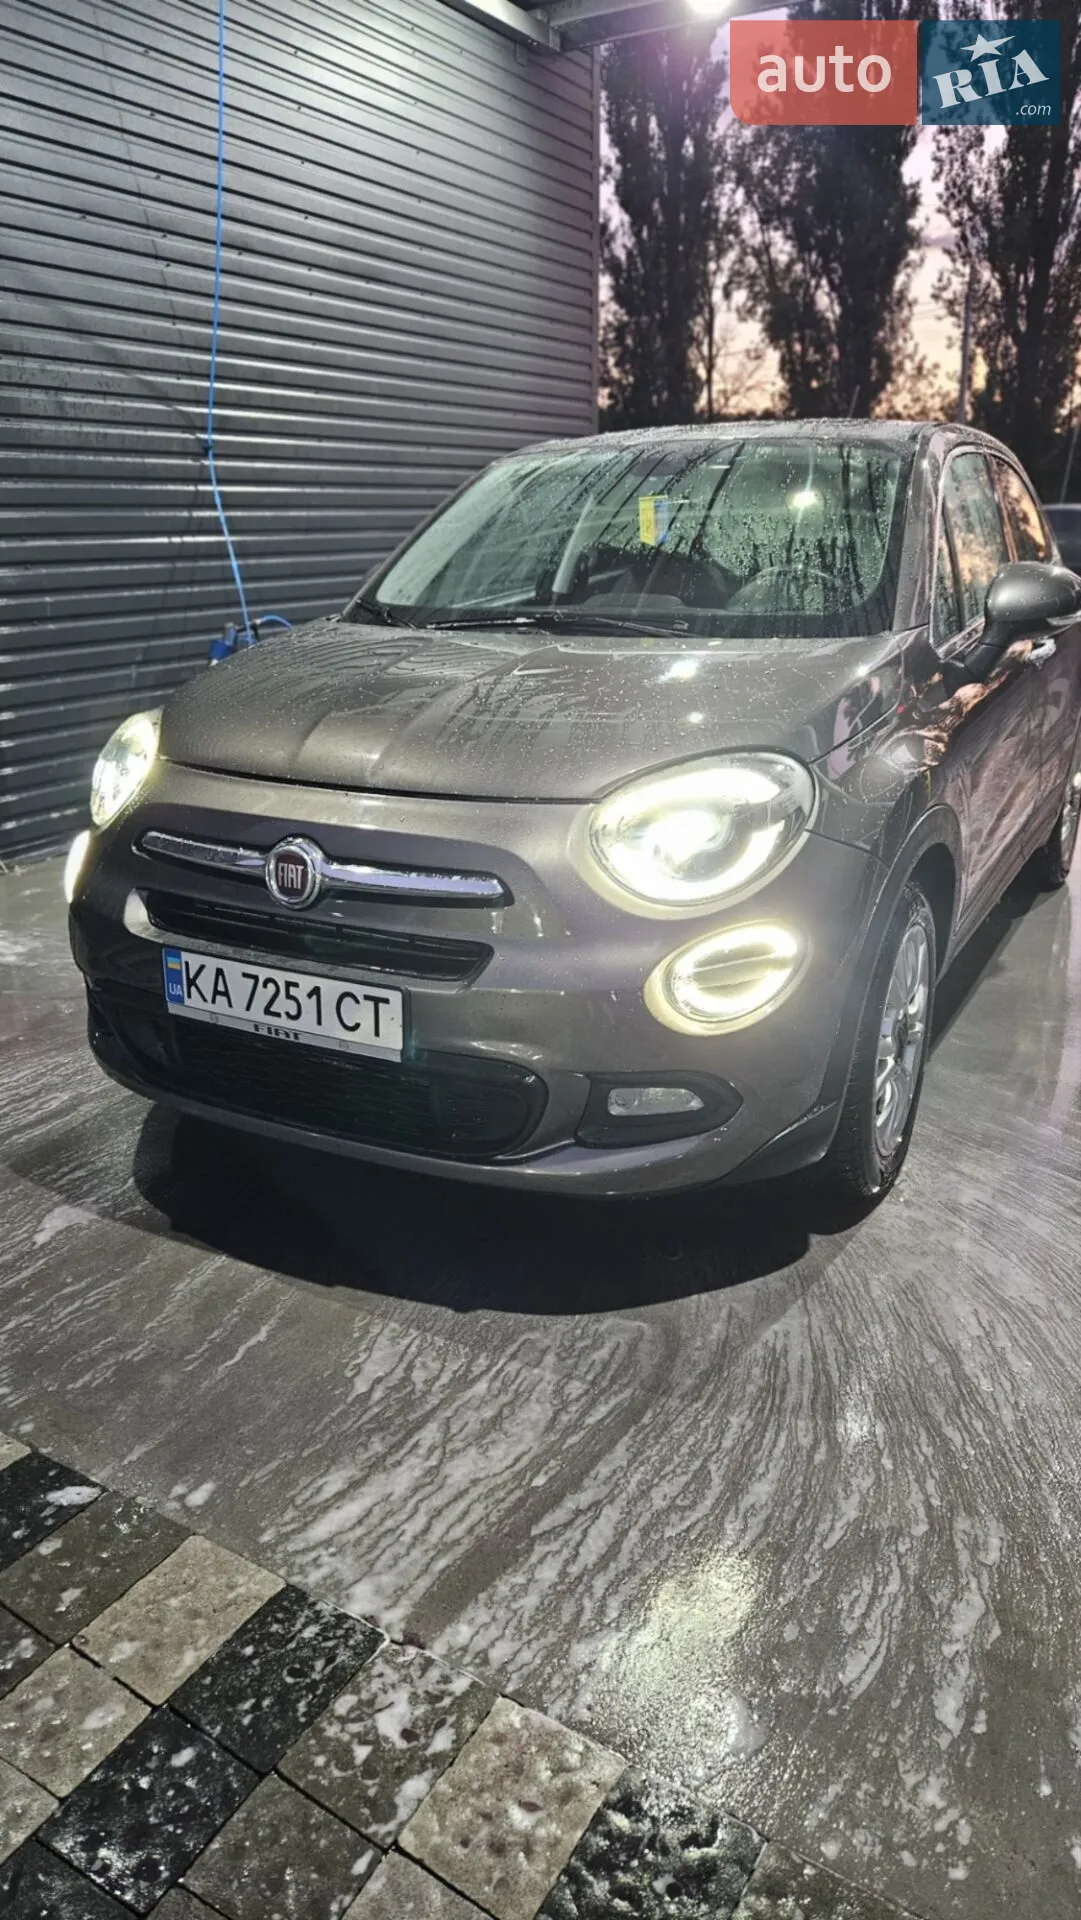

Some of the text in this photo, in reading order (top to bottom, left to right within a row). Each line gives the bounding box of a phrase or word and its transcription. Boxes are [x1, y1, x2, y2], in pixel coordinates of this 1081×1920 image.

[277, 862, 305, 889] FIAT
[168, 981, 183, 997] UA
[184, 960, 390, 1038] KA 7251 CT
